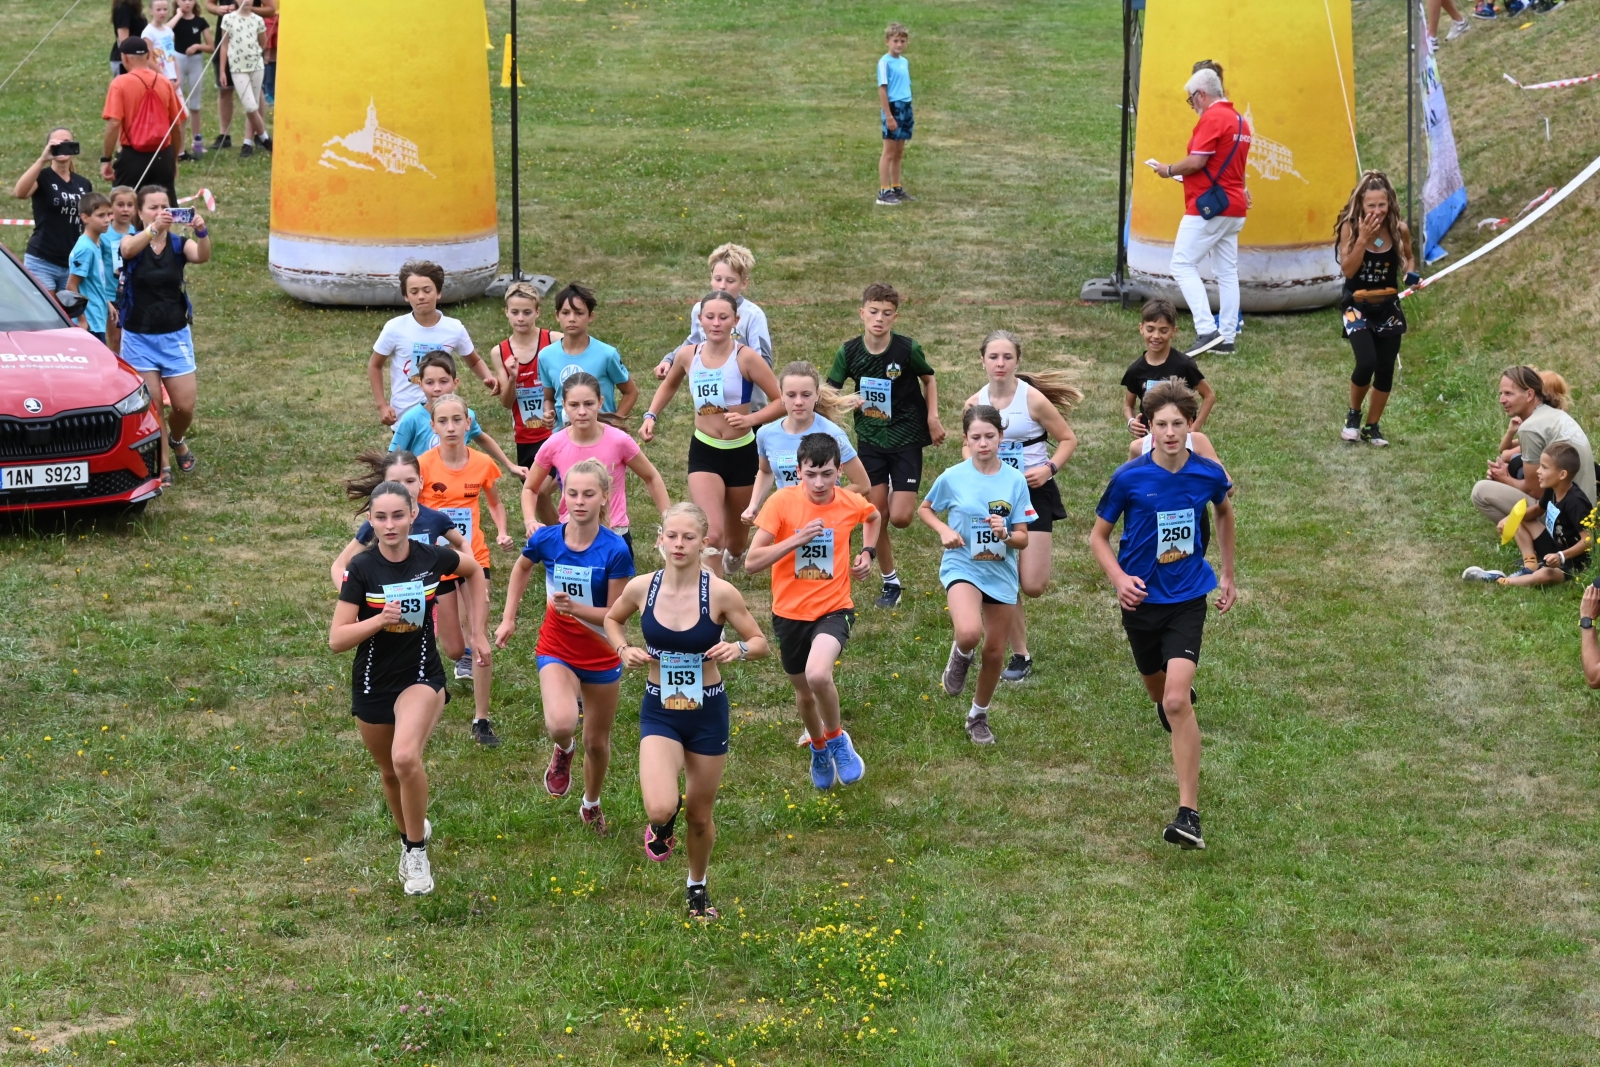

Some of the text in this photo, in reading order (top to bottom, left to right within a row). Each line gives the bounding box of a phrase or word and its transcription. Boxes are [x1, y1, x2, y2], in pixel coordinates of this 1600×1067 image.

[0, 353, 89, 364] Branka
[697, 383, 719, 398] 164
[865, 390, 886, 403] 159
[523, 399, 542, 411] 157
[7, 465, 81, 486] 1AN S923
[1162, 526, 1191, 543] 250
[801, 544, 828, 558] 251
[562, 582, 584, 597] 161
[391, 598, 421, 613] 53
[667, 670, 696, 686] 153
